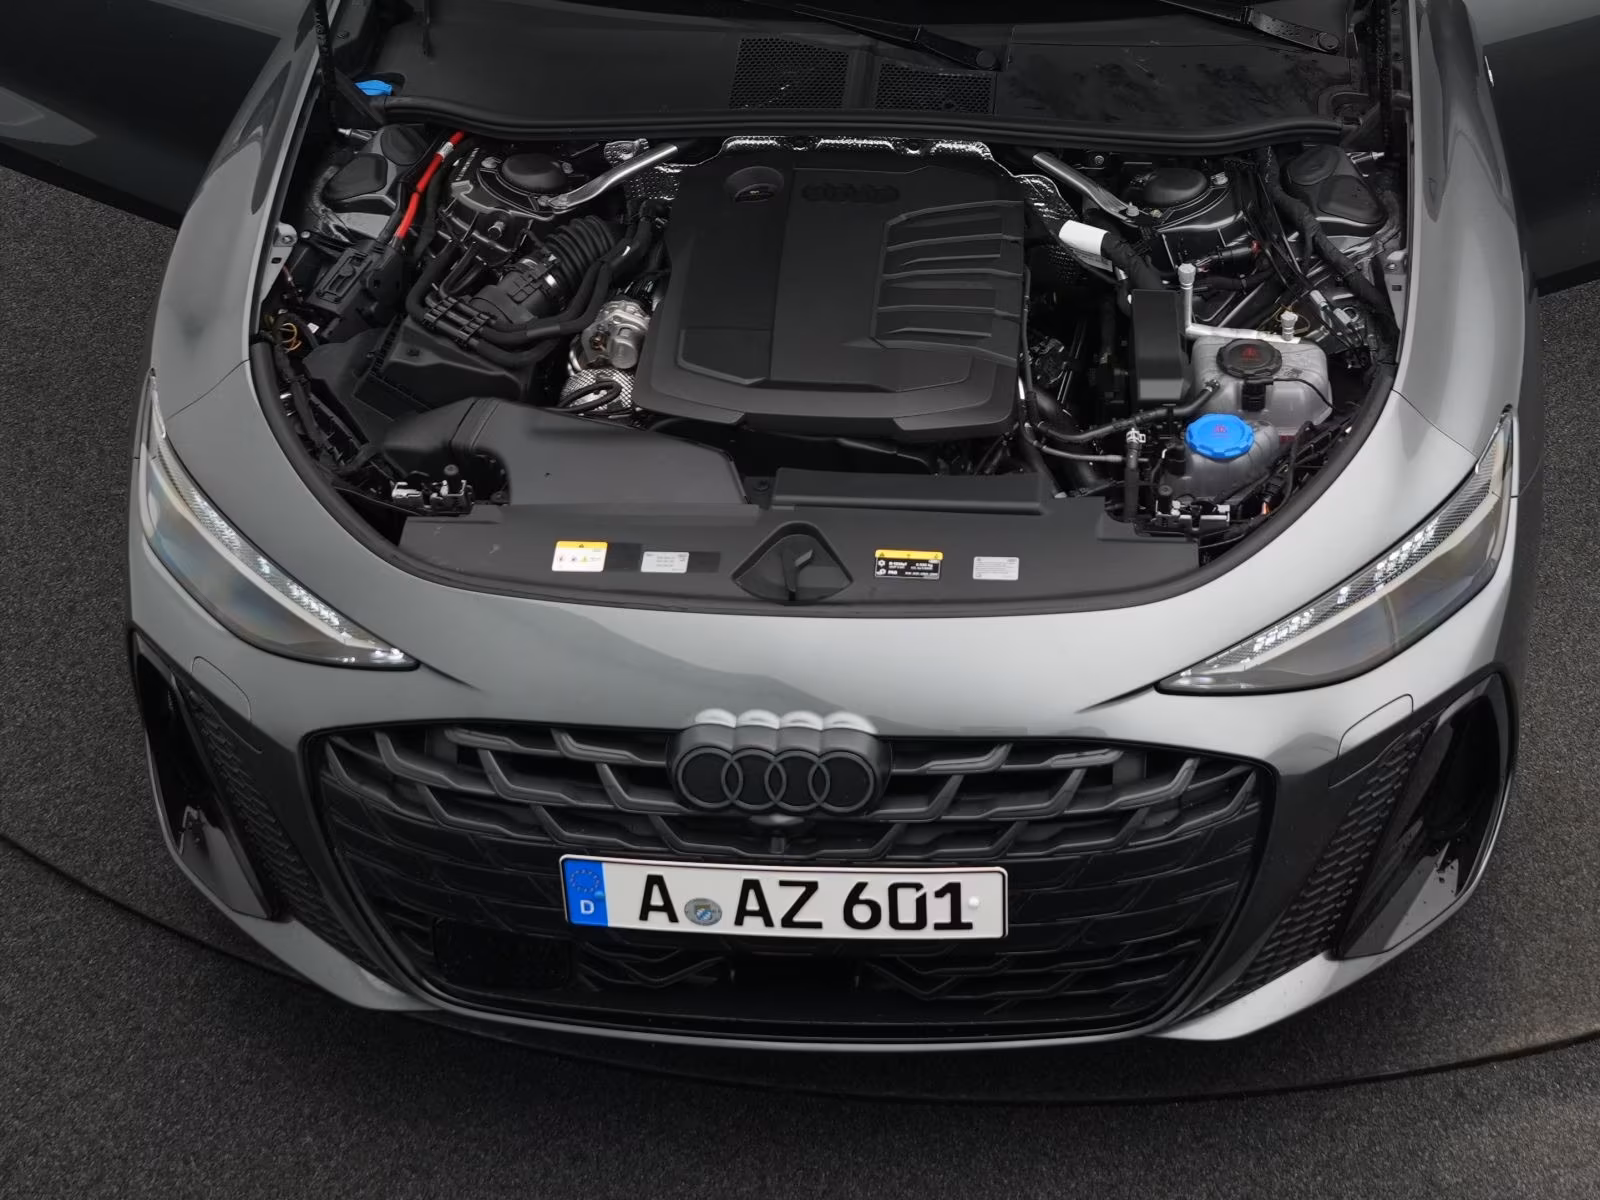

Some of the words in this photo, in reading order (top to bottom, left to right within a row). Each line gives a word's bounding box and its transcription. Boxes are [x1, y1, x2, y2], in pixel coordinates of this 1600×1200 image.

[580, 899, 594, 914] D
[638, 874, 679, 924] A
[733, 878, 823, 930] AZ
[842, 881, 974, 931] 601
